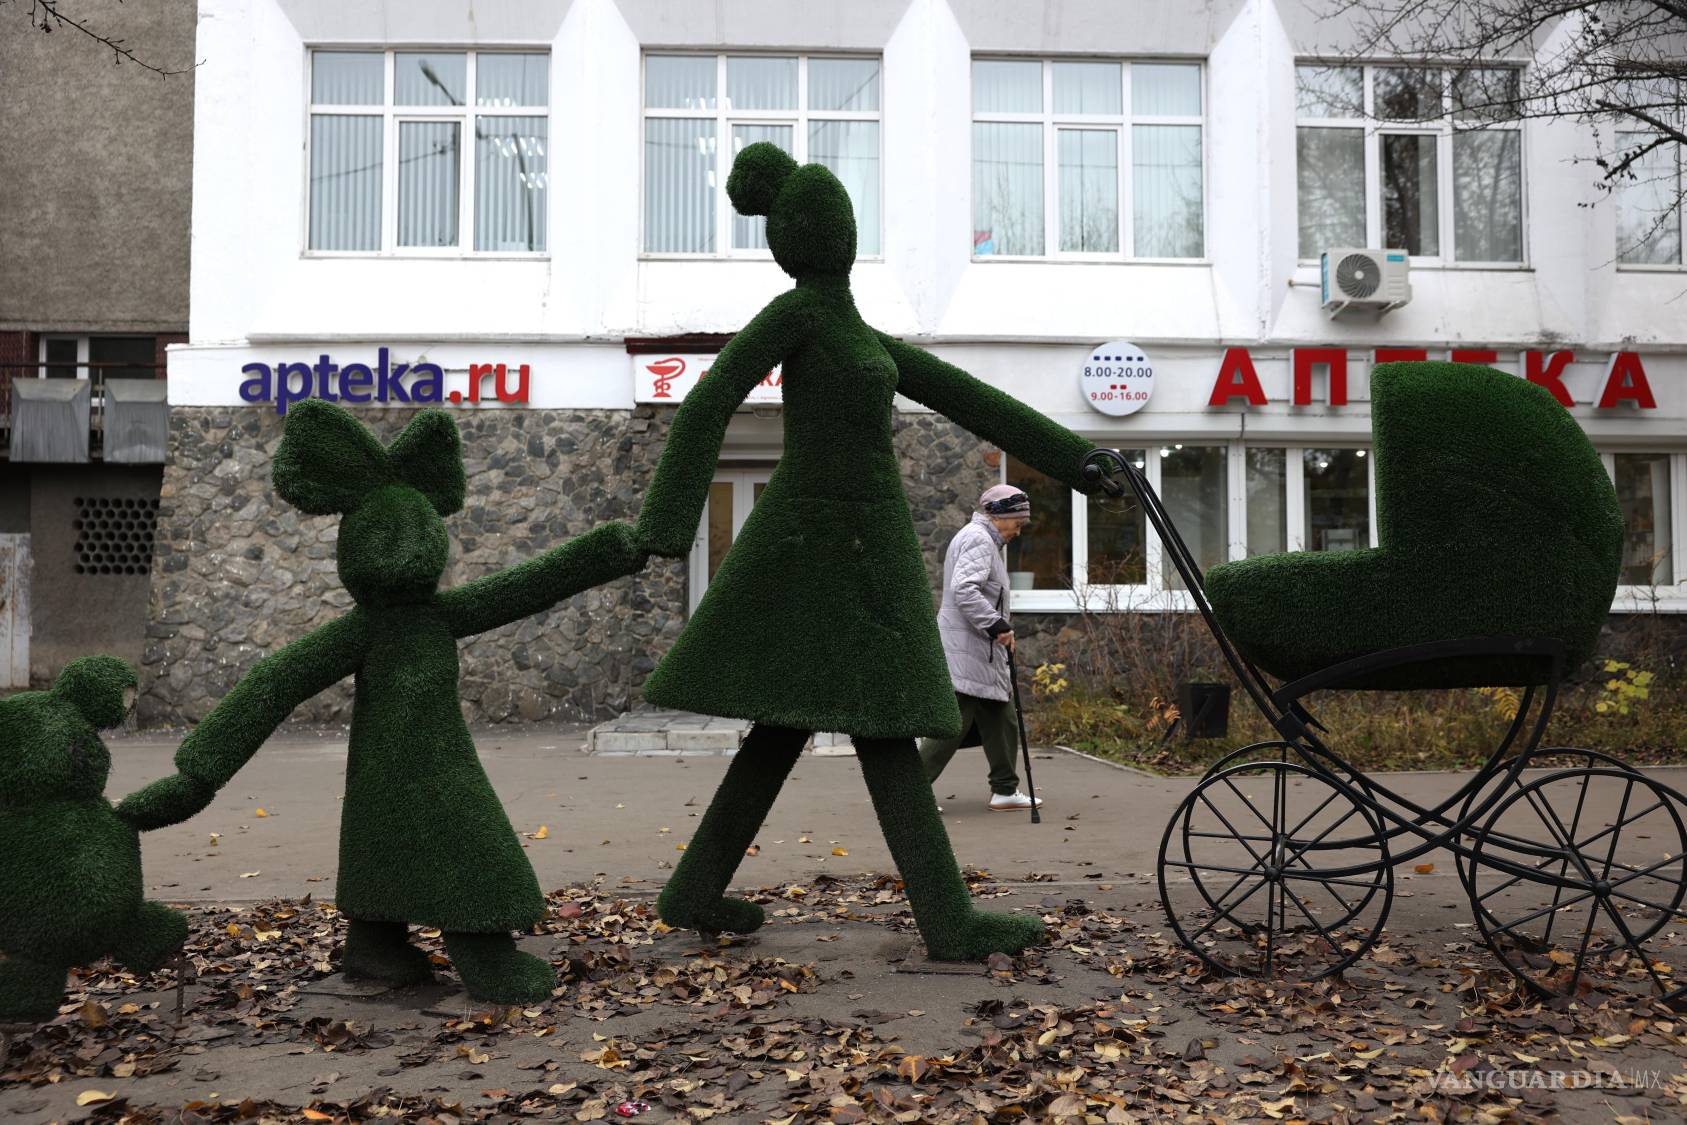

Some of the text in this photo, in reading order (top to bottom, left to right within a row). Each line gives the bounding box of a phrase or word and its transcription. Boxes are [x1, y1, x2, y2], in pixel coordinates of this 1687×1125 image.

[238, 347, 531, 415] apteka.ru
[1084, 366, 1153, 378] 8.00-20.00
[1208, 347, 1657, 409] АПКА
[1090, 391, 1148, 401] 9.00-16.00
